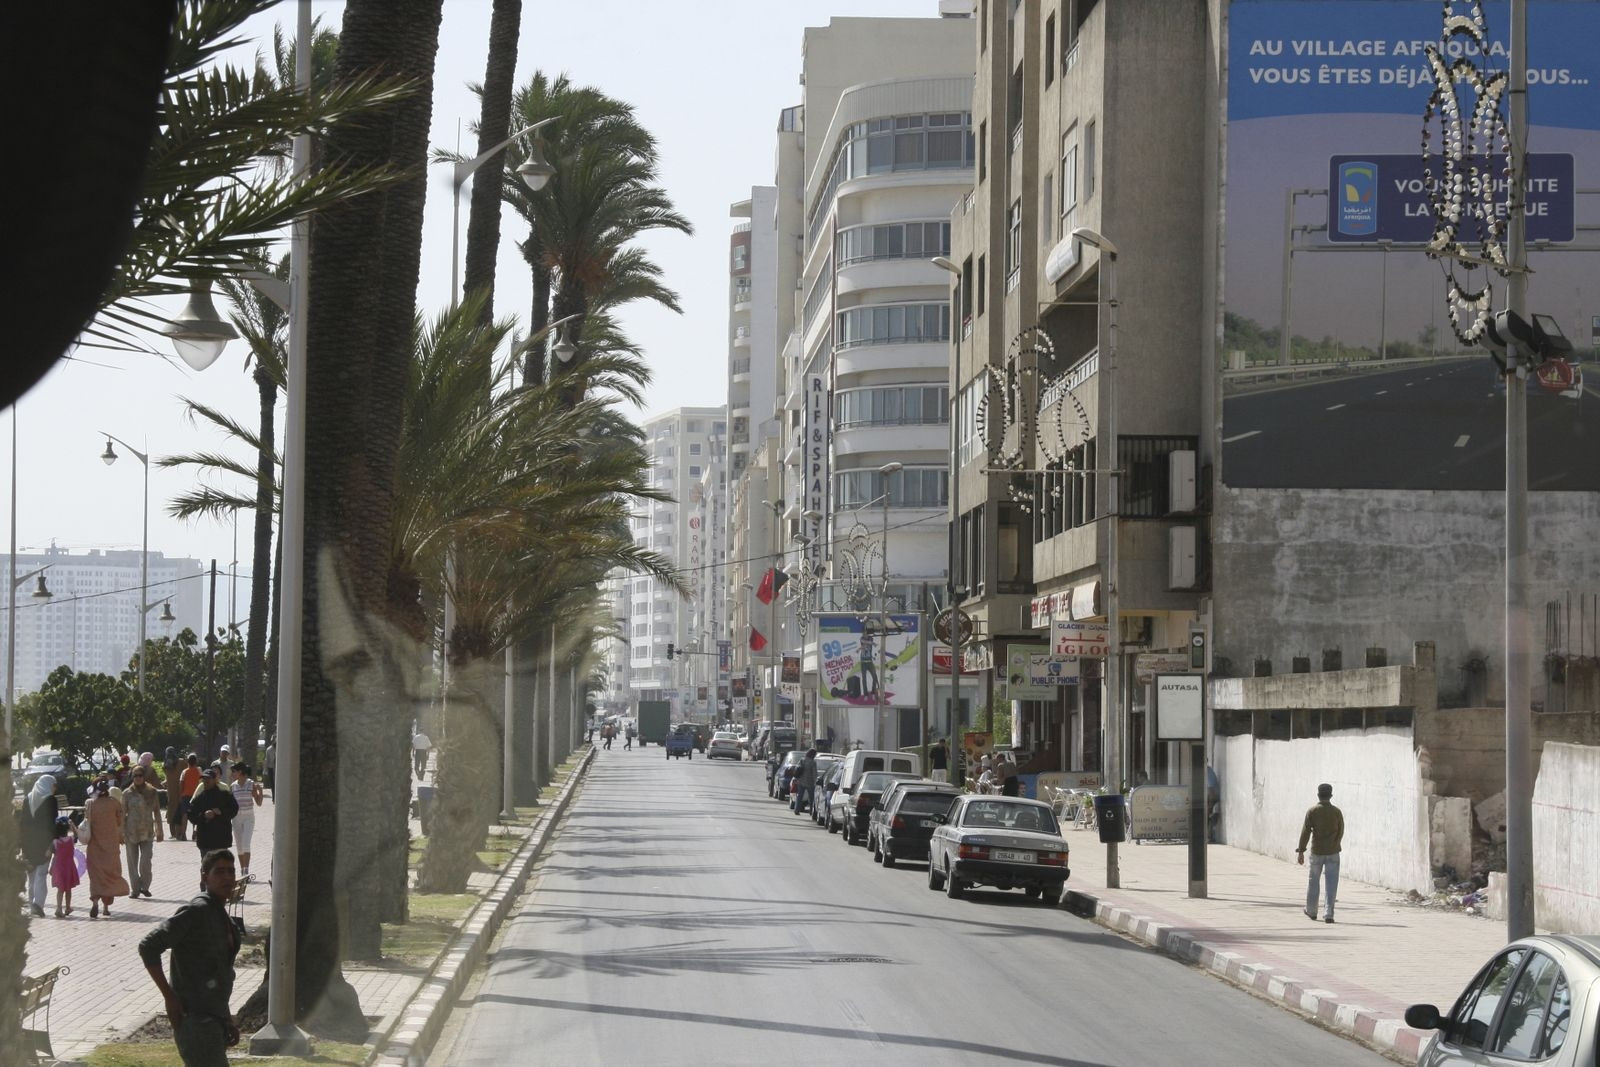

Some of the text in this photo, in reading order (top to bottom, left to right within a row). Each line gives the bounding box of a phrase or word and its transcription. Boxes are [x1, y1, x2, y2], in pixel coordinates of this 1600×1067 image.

[1249, 40, 1283, 56] AU
[1291, 40, 1386, 56] VILLAGE
[1249, 68, 1311, 84] VOUS
[1318, 63, 1372, 84] ÊTES
[1379, 64, 1434, 89] DÉJÀ
[1525, 68, 1589, 85] OUS...
[1394, 179, 1449, 193] VOU
[1404, 202, 1430, 217] LA
[811, 378, 823, 574] RIF & SPA HTEL
[1057, 623, 1086, 631] GLACIER
[822, 639, 842, 660] 99
[1031, 676, 1079, 685] PUBLIC PHONE
[1161, 684, 1199, 692] AUTASA
